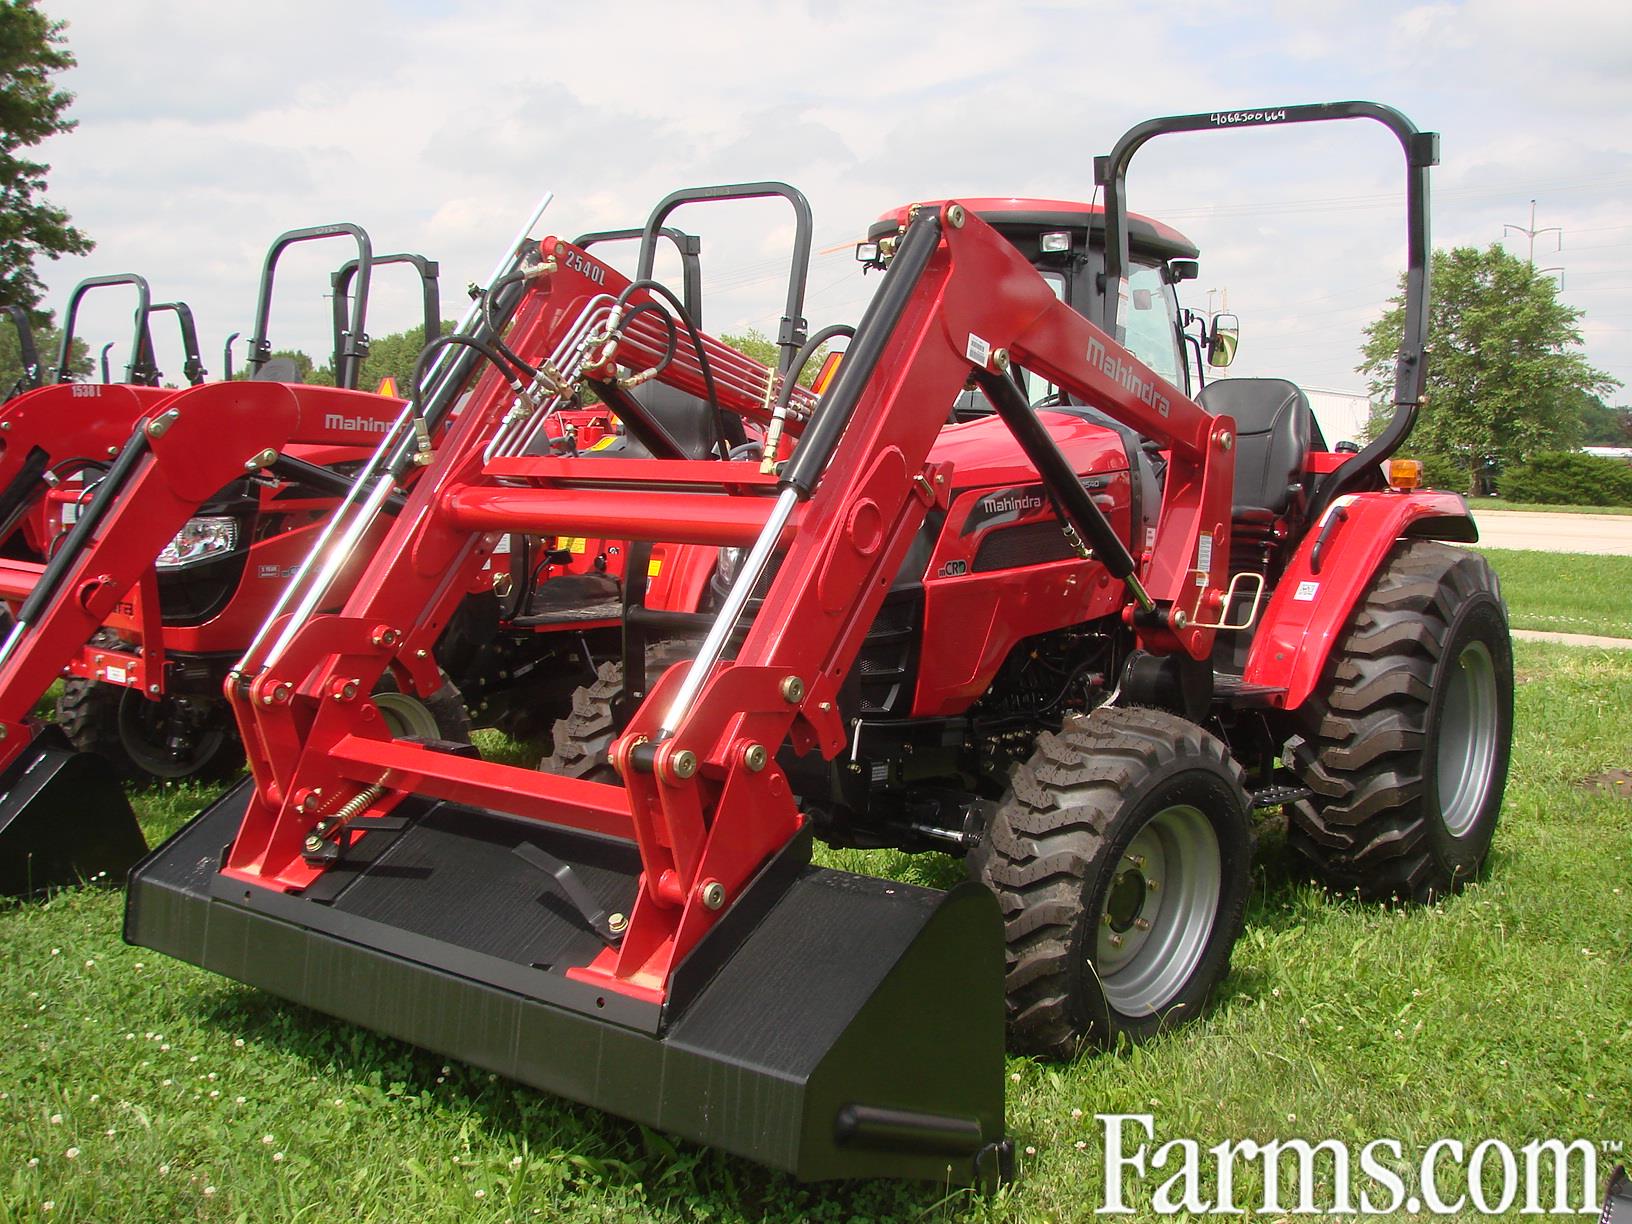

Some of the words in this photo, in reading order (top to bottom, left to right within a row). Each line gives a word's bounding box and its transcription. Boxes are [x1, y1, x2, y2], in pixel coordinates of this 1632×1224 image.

[565, 250, 606, 286] 2540L
[1086, 335, 1171, 418] Mahindra
[983, 495, 1041, 513] Mahindra
